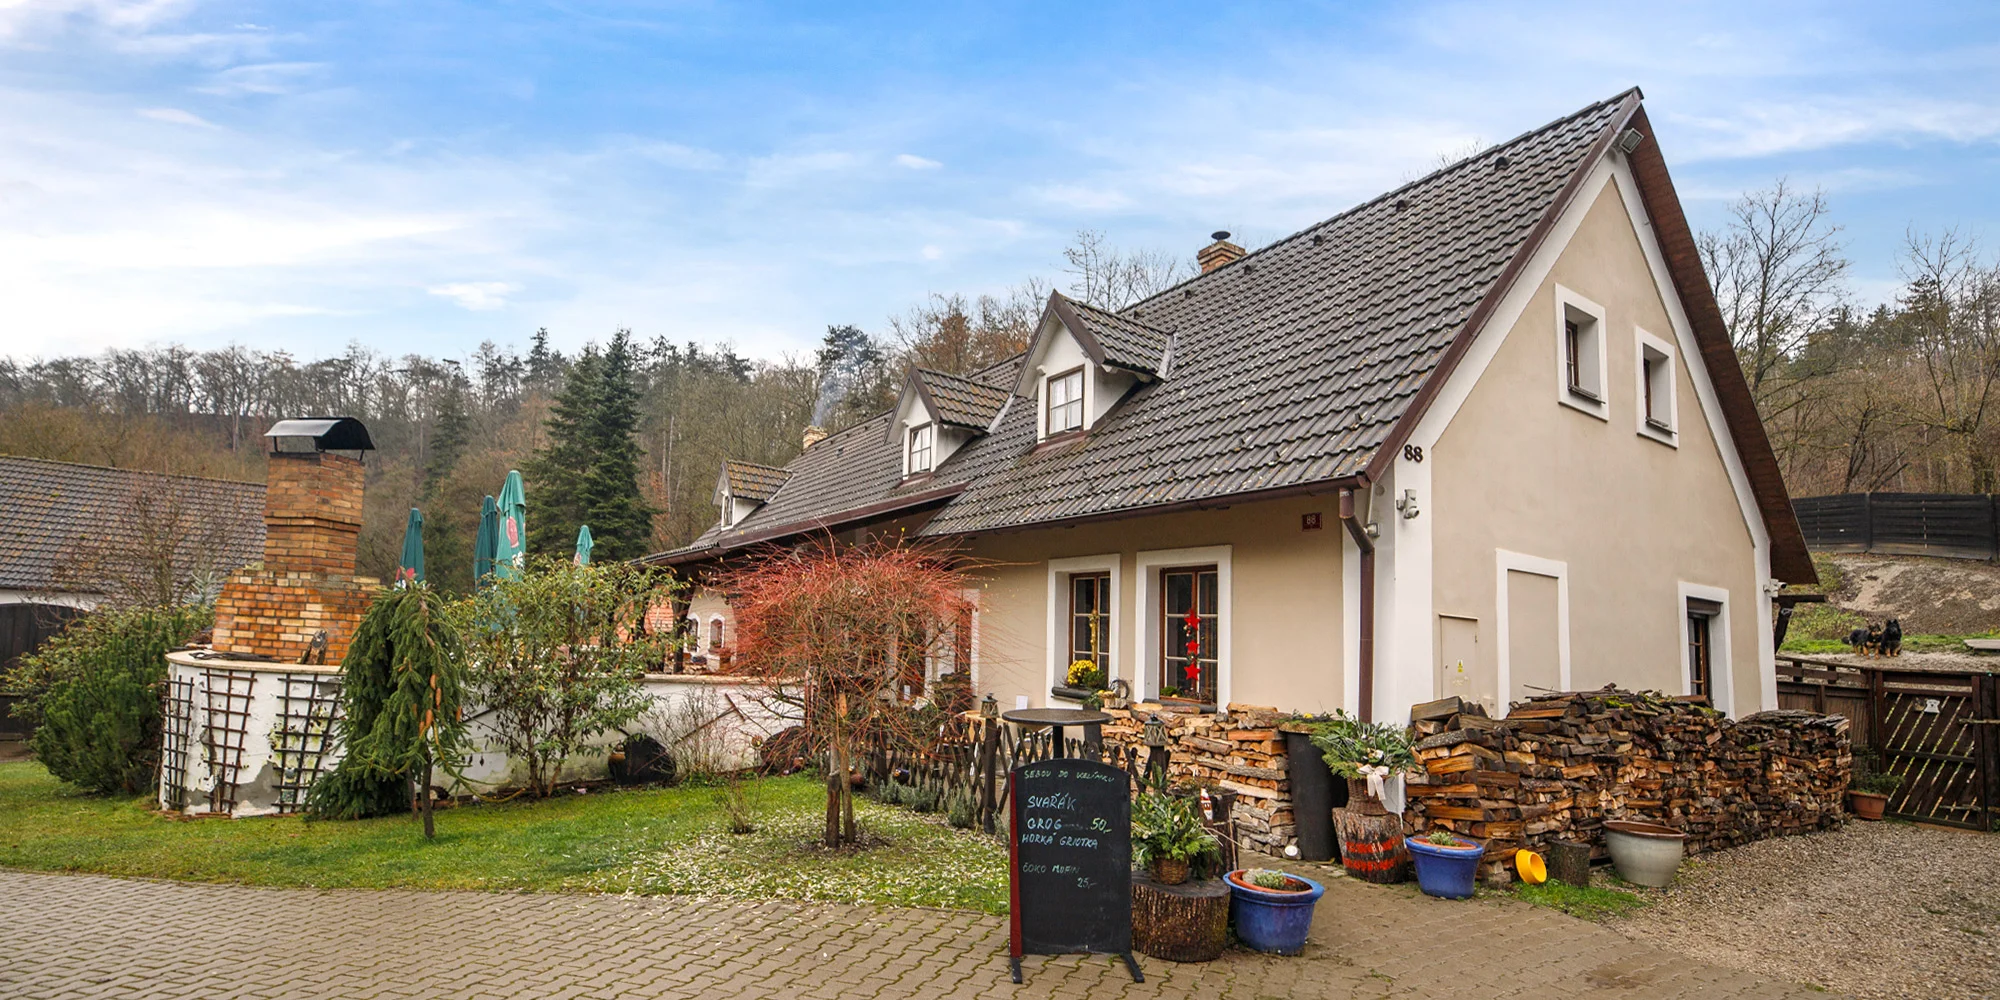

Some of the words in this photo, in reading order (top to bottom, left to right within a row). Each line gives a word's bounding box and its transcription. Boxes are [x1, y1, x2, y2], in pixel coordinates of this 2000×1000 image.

[1404, 444, 1423, 463] 88
[1306, 514, 1316, 525] 88
[1027, 792, 1077, 811] SVAŘÁK
[1027, 817, 1062, 830] GROG
[1060, 836, 1098, 849] GRIOTKA
